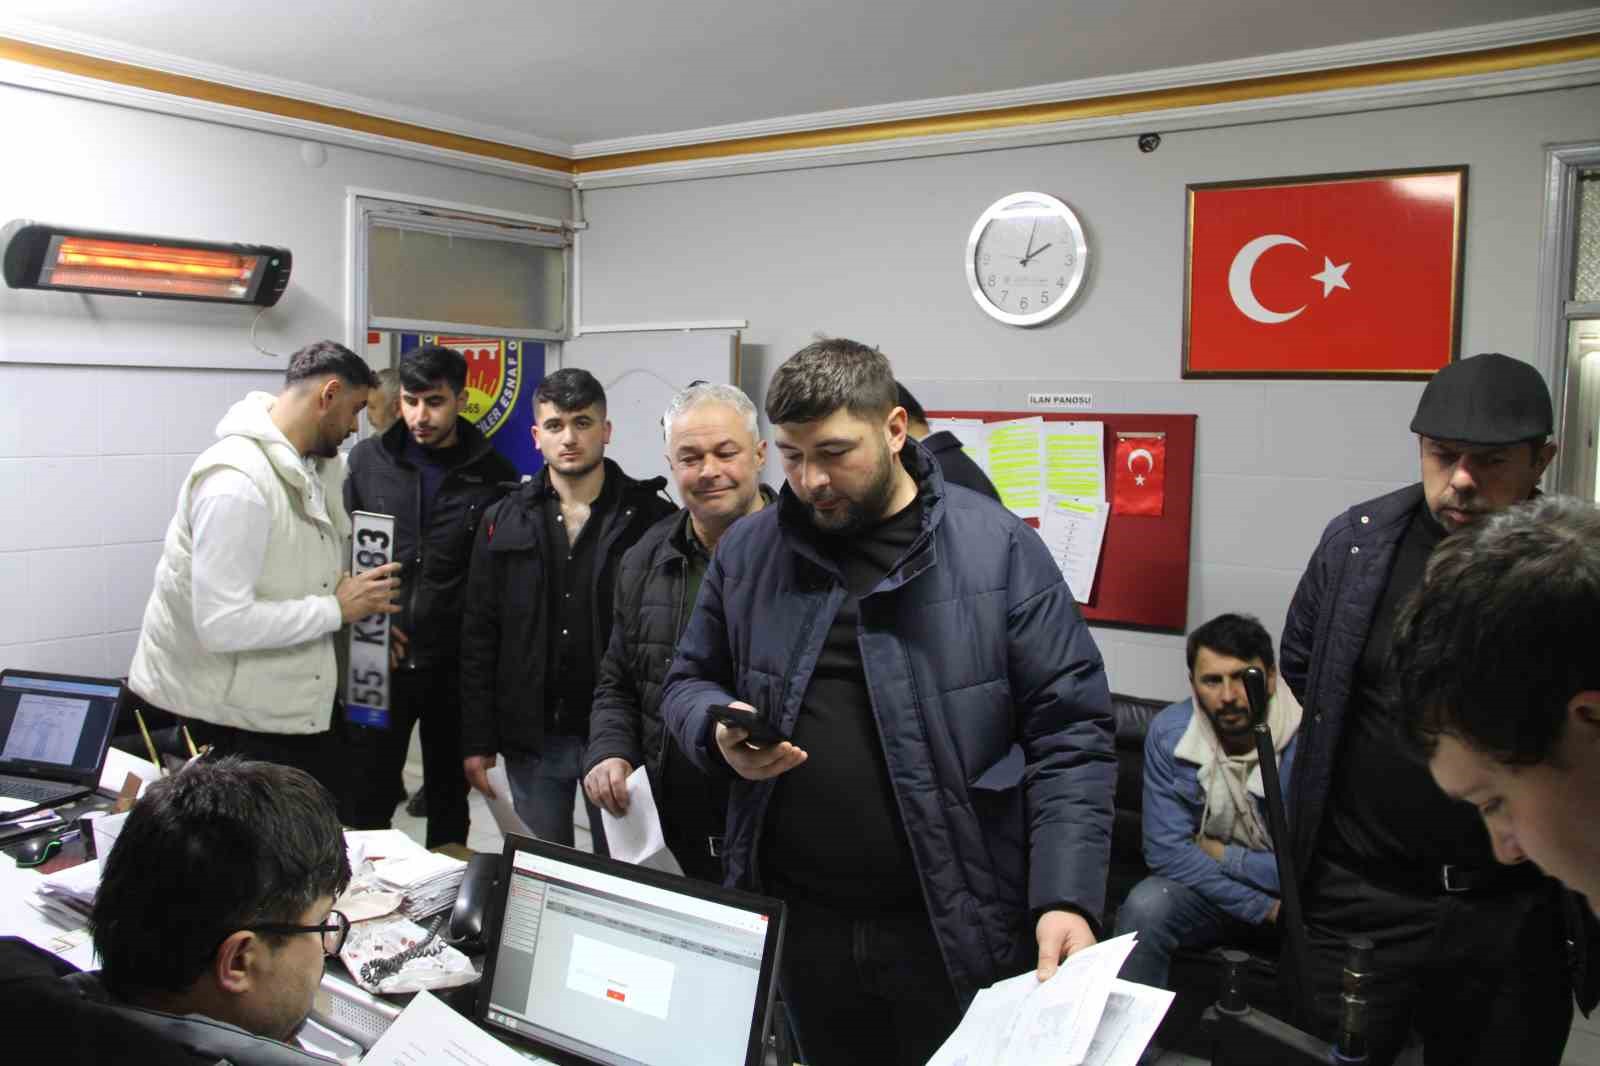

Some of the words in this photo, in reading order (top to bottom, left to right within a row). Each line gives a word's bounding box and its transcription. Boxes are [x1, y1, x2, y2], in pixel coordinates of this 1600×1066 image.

[500, 358, 517, 408] ESNAF
[1053, 396, 1091, 404] PANOSU
[353, 669, 384, 706] 55
